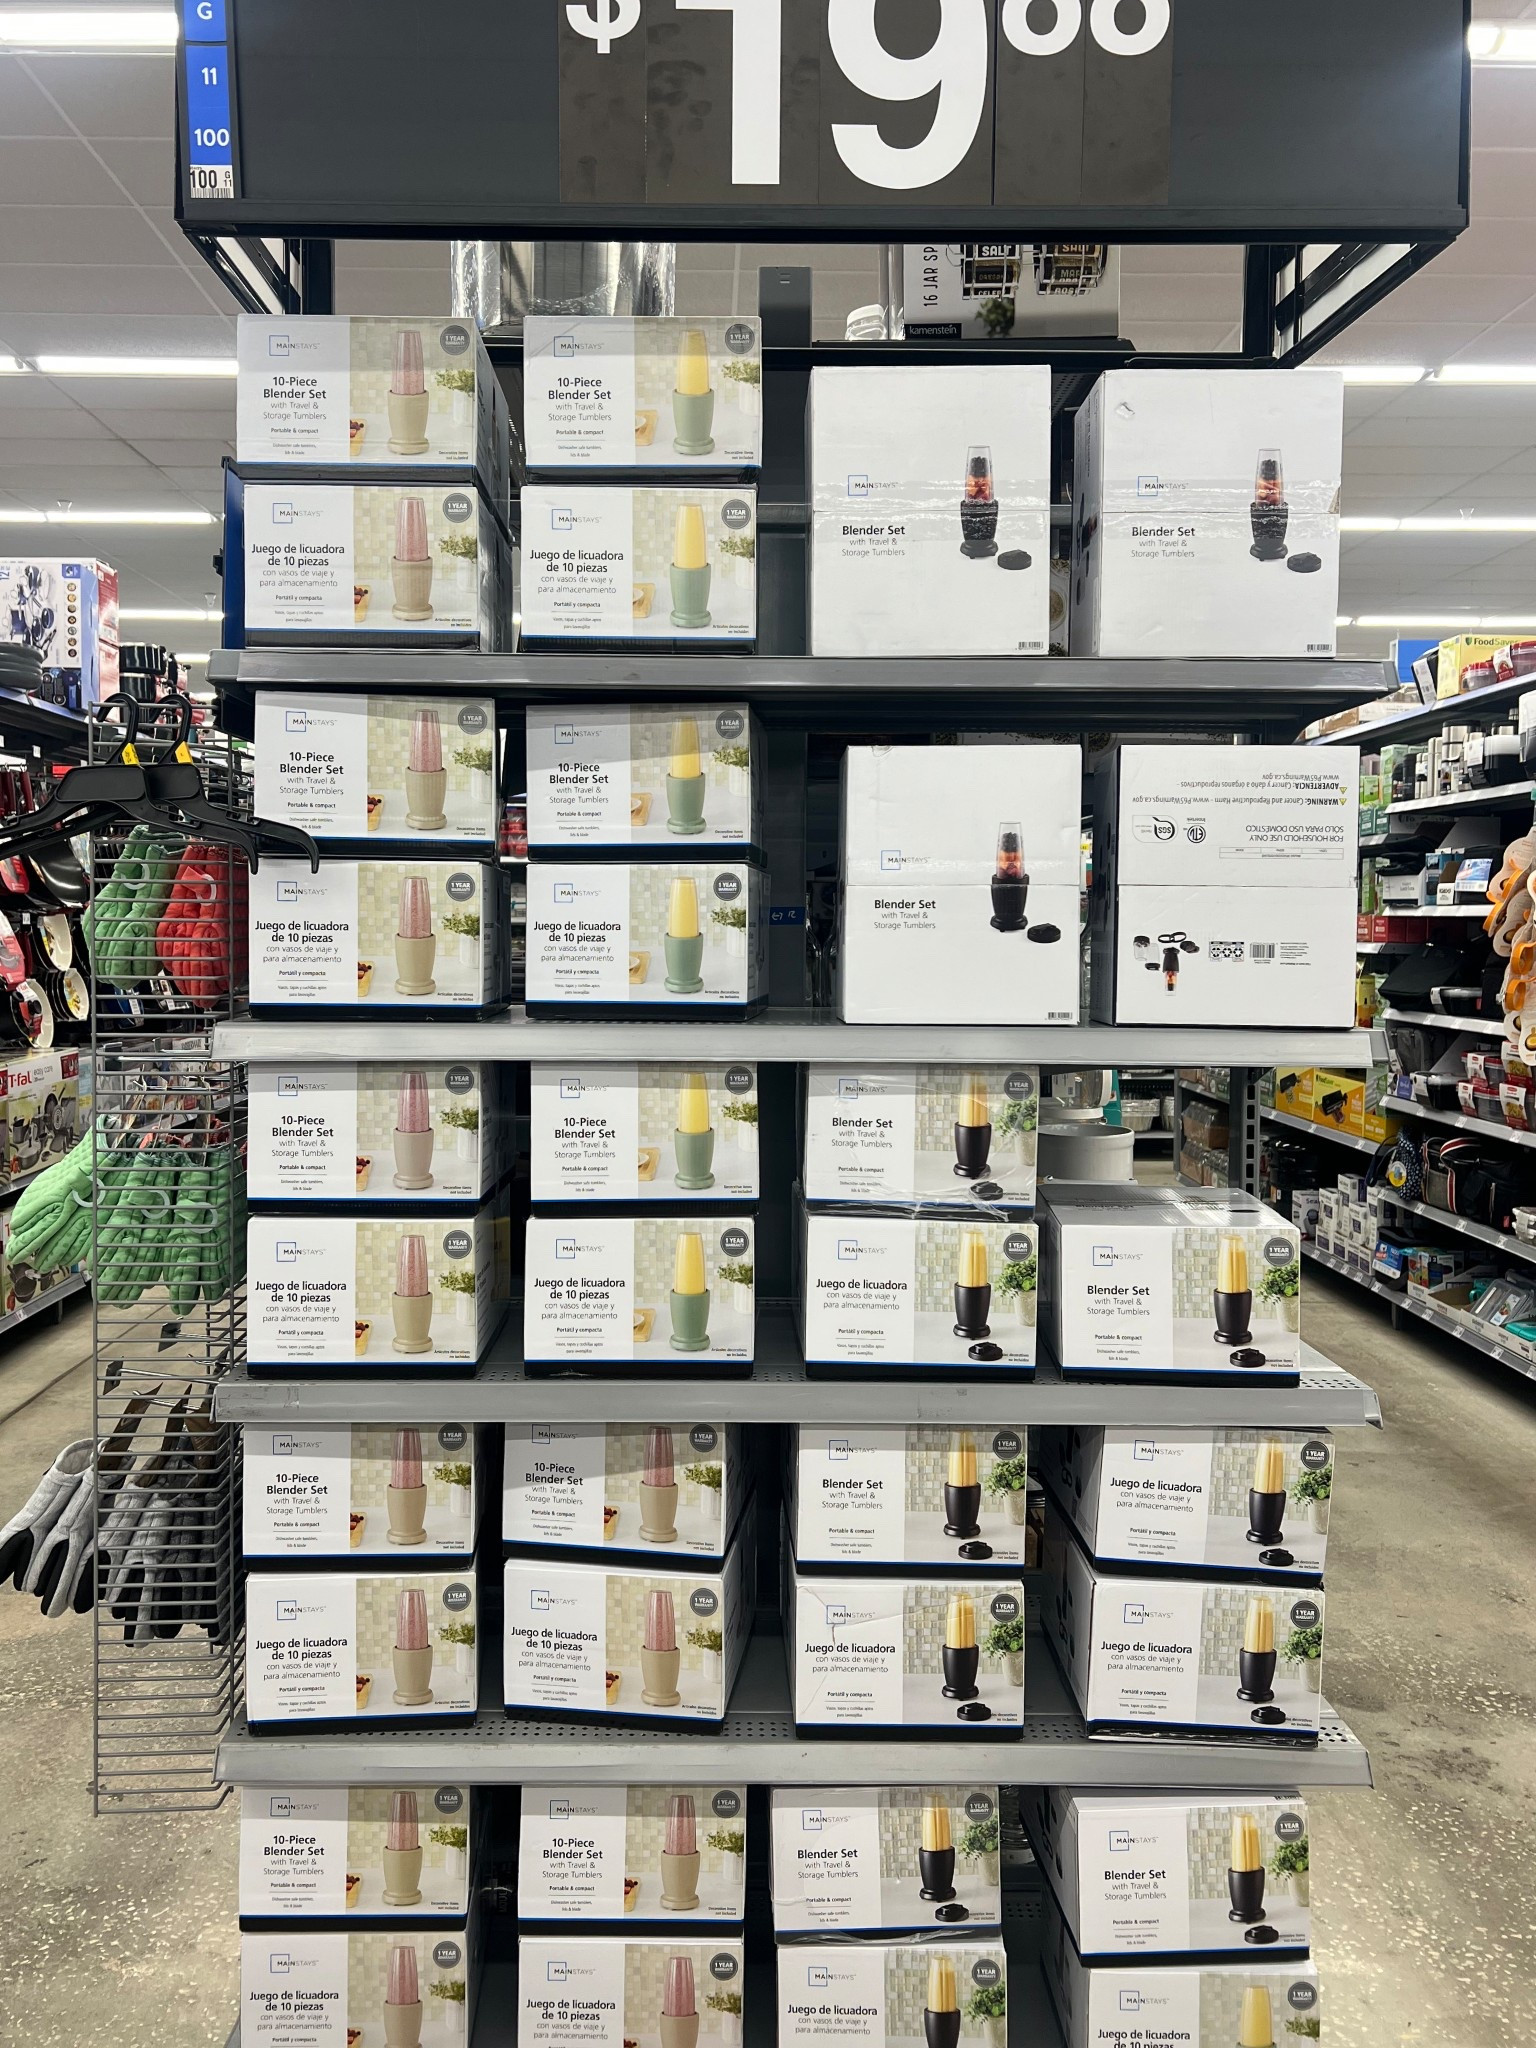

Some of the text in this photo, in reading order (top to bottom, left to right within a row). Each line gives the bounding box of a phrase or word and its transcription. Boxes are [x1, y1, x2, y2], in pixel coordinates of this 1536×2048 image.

[197, 2, 213, 20] G
[202, 67, 218, 86] 11
[194, 128, 230, 147] 100
[190, 169, 218, 189] 100
[981, 245, 1013, 257] SALT
[923, 267, 939, 290] JAR
[923, 294, 938, 307] 16
[909, 325, 958, 335] kamenstein
[276, 342, 320, 350] MAINSTAYS
[273, 376, 318, 387] 10-Piece
[557, 377, 602, 388] 10-Piece
[264, 388, 327, 399] Blender Set
[548, 389, 612, 400] Blender Set
[270, 401, 319, 410] with Travel &
[263, 411, 327, 422] Storage Tumblers
[558, 515, 599, 523] MAINSTAYS
[843, 525, 906, 536] Blender Set
[1132, 526, 1196, 537] Blender Set
[251, 543, 345, 556] Juego de licuadora
[529, 549, 624, 562] Juego de licuadora
[267, 556, 329, 568] de 10 piezas
[546, 562, 608, 574] de 10 piezas
[578, 575, 589, 583] de
[590, 577, 607, 585] viaje
[537, 585, 617, 595] para almacenamiento
[292, 718, 337, 727] MAINSTAYS
[289, 751, 335, 763] 10-Piece
[280, 763, 344, 775] Blender Set
[558, 762, 600, 773] 10-Piece
[550, 774, 609, 784] Blender Set
[1292, 781, 1339, 790] ADVERTENCIA:
[1214, 797, 1231, 805] Harm
[1231, 796, 1271, 805] Reproductive
[1271, 797, 1283, 805] and
[1283, 797, 1304, 806] Cancer
[1304, 797, 1339, 806] WARNING:
[1248, 834, 1344, 843] FOR HOUSEHOLD USE ONLY
[874, 899, 936, 909] Blender Set
[881, 911, 929, 919] with Travel &
[873, 921, 936, 931] Storage Tumblers
[281, 1115, 325, 1126] 10-Piece
[832, 1117, 893, 1129] Blender Set
[272, 1127, 334, 1137] Blender Set
[283, 1248, 324, 1256] MAINSTAYS
[1099, 1253, 1143, 1261] MAINSTAYS
[534, 1277, 626, 1289] Juego de licuadora
[816, 1279, 908, 1291] Juego de licuadora
[550, 1289, 610, 1301] de 10 piezas
[1087, 1285, 1150, 1296] Blender Set
[276, 1473, 319, 1483] 10-Piece
[267, 1484, 328, 1495] Blender Set
[822, 1478, 883, 1490] Blender Set
[1110, 1477, 1202, 1493] Juego de licuadora
[805, 1643, 896, 1655] Juego de licuadora
[1101, 1641, 1193, 1654] Juego de licuadora
[552, 1838, 595, 1848] 10-Piece
[1116, 1836, 1156, 1844] MAINSTAYS
[543, 1849, 603, 1859] Blender Set
[1104, 1869, 1166, 1881] Blender Set
[249, 1990, 339, 2003] Juego de licuadora
[265, 2001, 324, 2013] de 10 piezas
